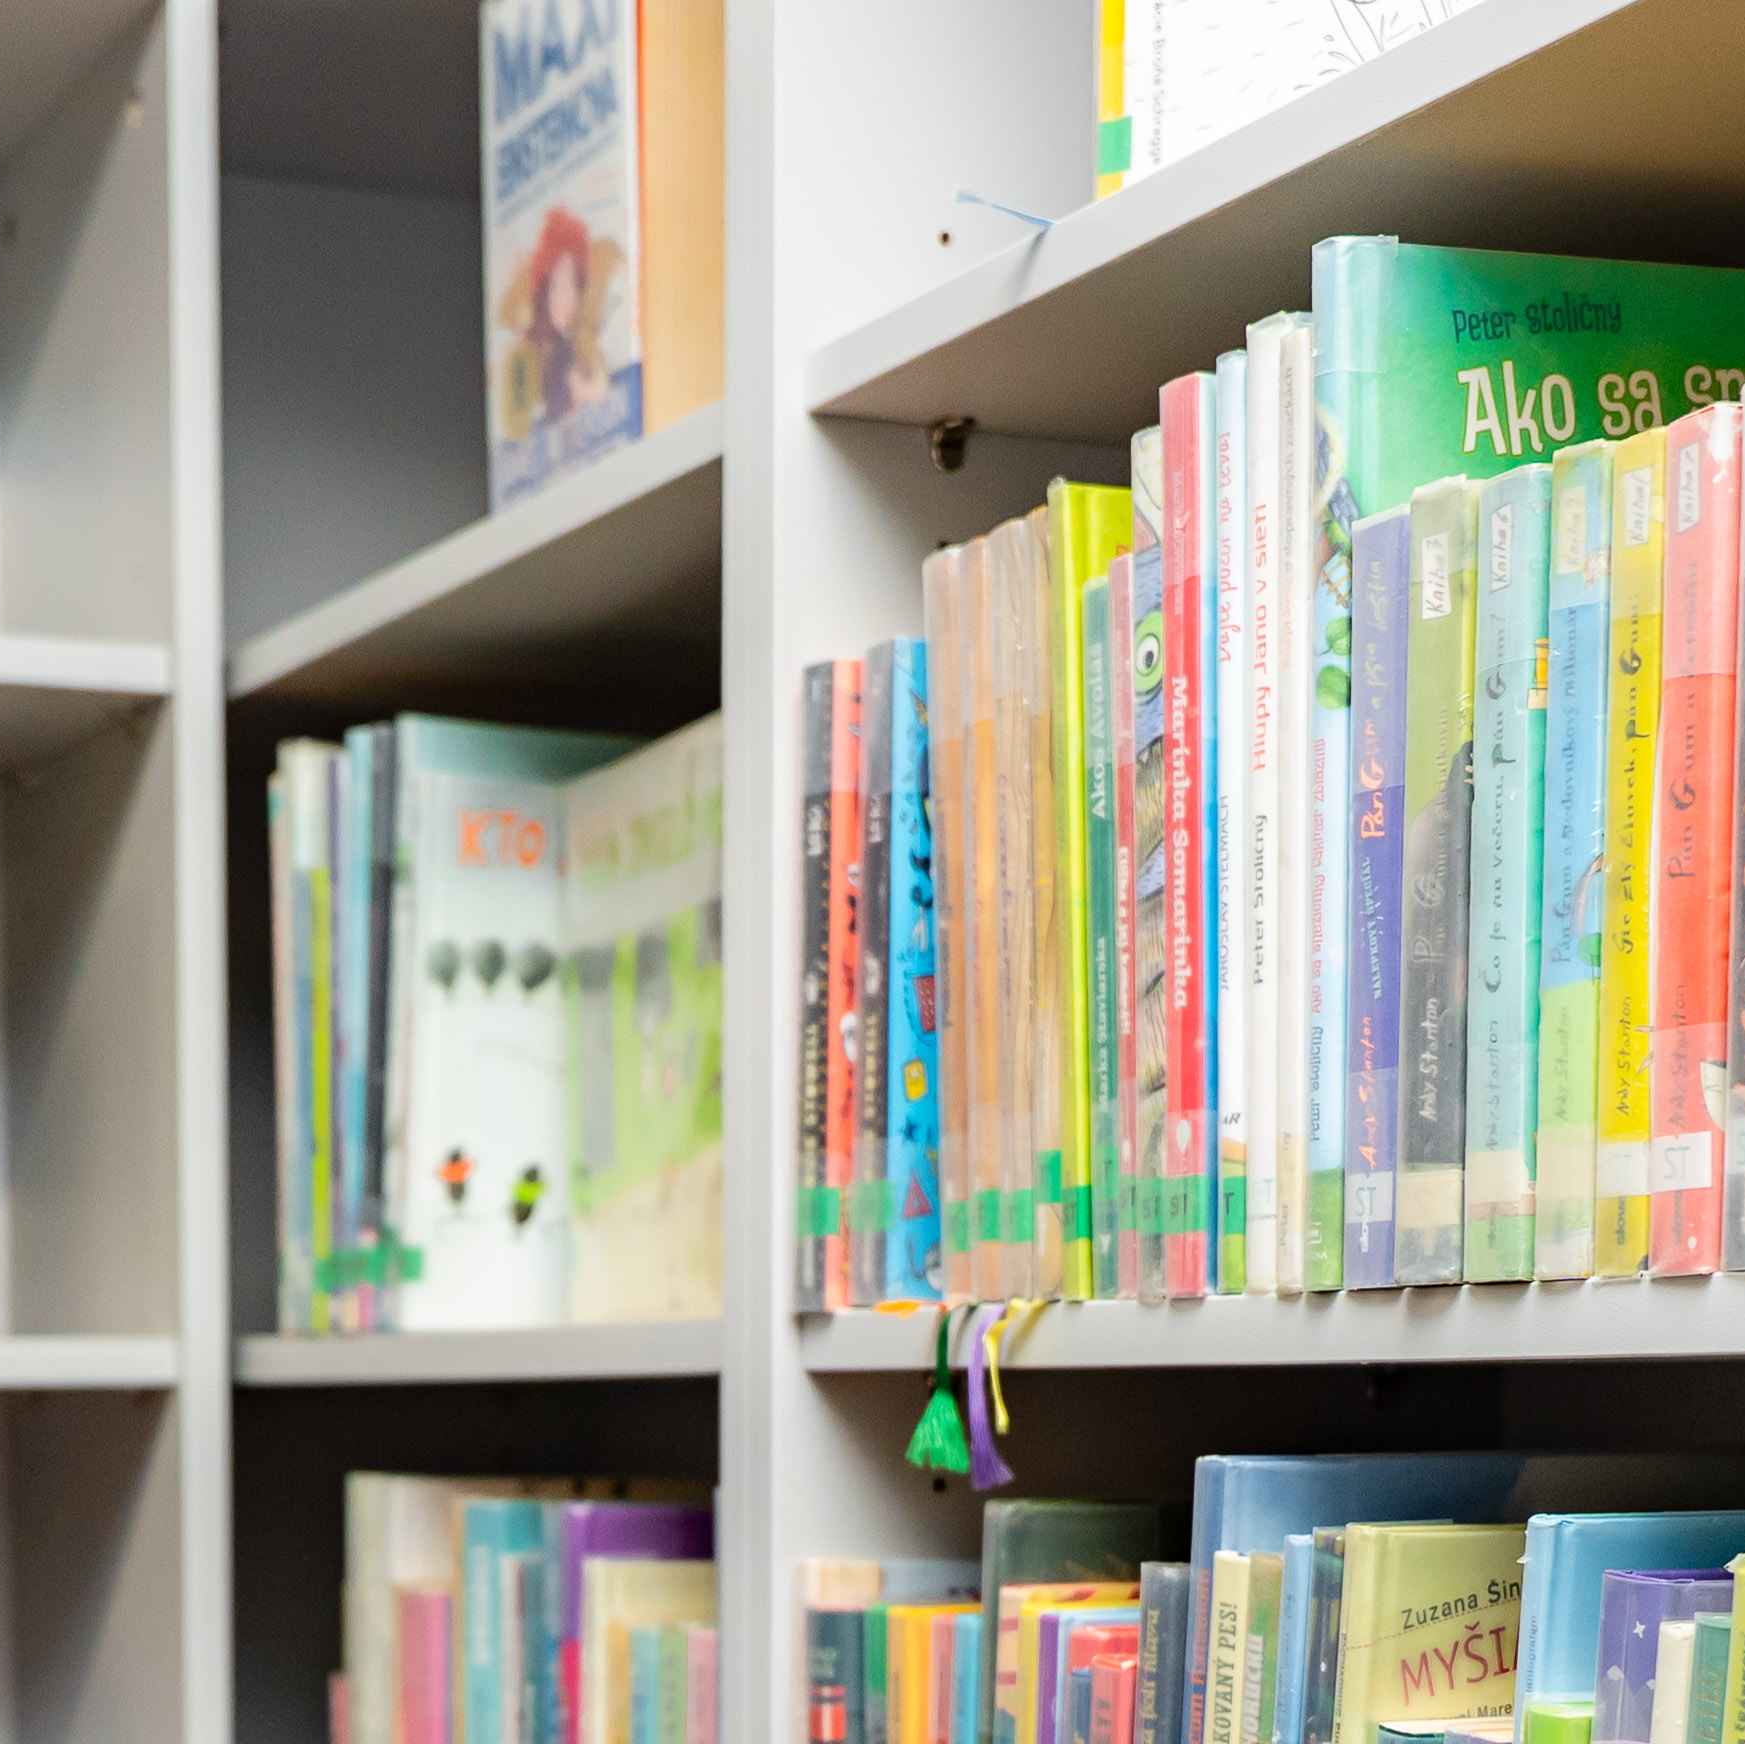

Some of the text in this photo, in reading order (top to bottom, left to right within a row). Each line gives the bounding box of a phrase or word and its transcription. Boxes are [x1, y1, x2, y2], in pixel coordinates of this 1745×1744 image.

[1453, 292, 1624, 344] Peter Stoličný
[1455, 359, 1577, 456] Ako
[1597, 369, 1665, 438] sa
[1282, 453, 1297, 556] dopravných
[1254, 503, 1268, 674] Jano v sieti
[1623, 686, 1651, 743] pán
[456, 806, 549, 872] KTO
[1169, 676, 1192, 1011] Marinka Somarinka
[1359, 791, 1386, 839] Pán
[1665, 724, 1698, 880] Pán Gum
[1477, 710, 1517, 994] Čo je na večeru, pán
[1252, 918, 1264, 986] Peter
[1358, 1016, 1376, 1103] Stanton
[1419, 996, 1440, 1122] Andy Stanton
[1613, 995, 1634, 1117] Andy Stanton
[1215, 1601, 1238, 1652] PES!
[1401, 1592, 1479, 1631] Zuzana
